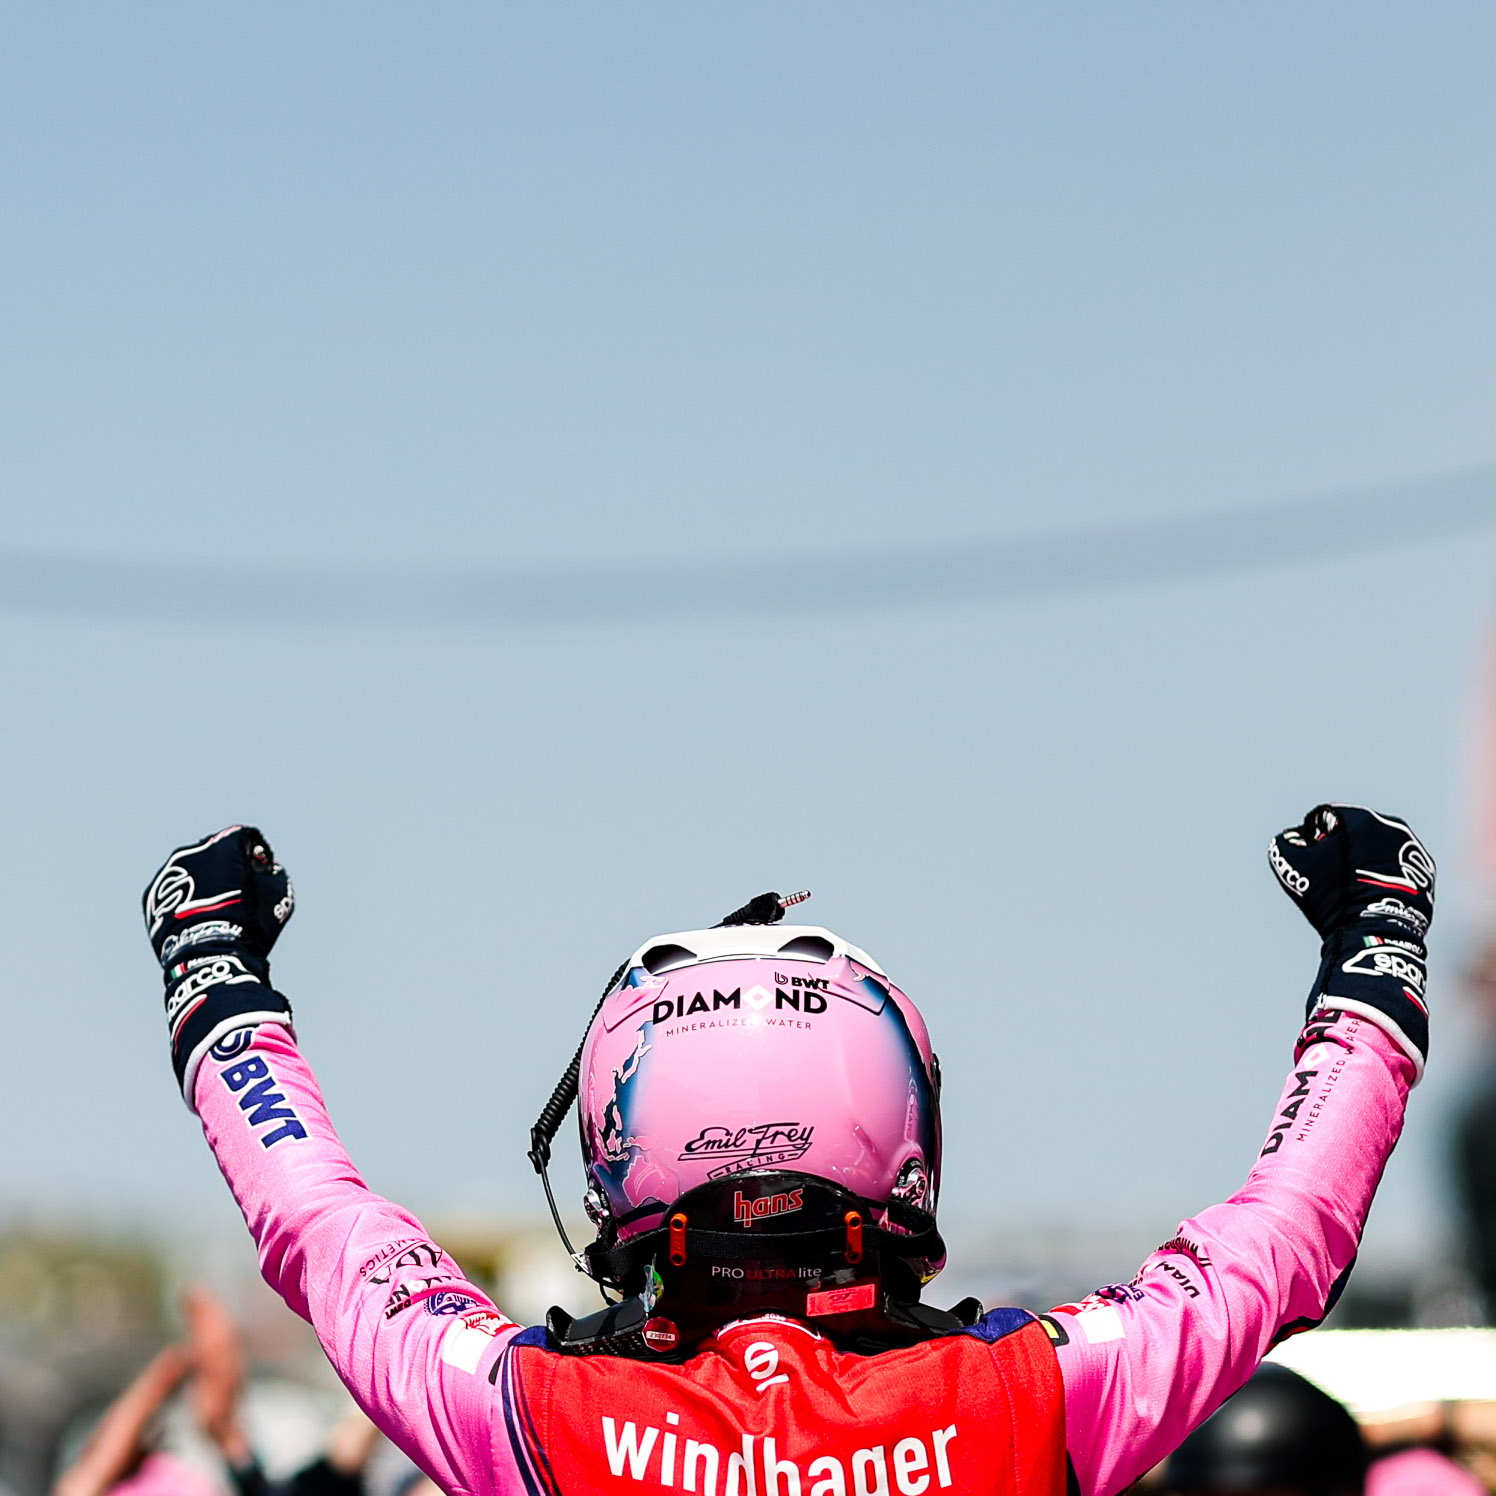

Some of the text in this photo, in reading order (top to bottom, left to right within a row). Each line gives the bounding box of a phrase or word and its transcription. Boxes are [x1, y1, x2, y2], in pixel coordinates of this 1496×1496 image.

[791, 976, 830, 991] BWT
[1373, 952, 1426, 988] spar
[167, 960, 231, 1019] parco
[666, 1018, 812, 1038] MINERALIZE WATER
[219, 1055, 309, 1150] BWT
[1295, 1059, 1346, 1142] MINERALIZED
[684, 1122, 815, 1158] Emil Frey
[724, 1153, 786, 1175] RACING
[733, 1188, 804, 1228] hans
